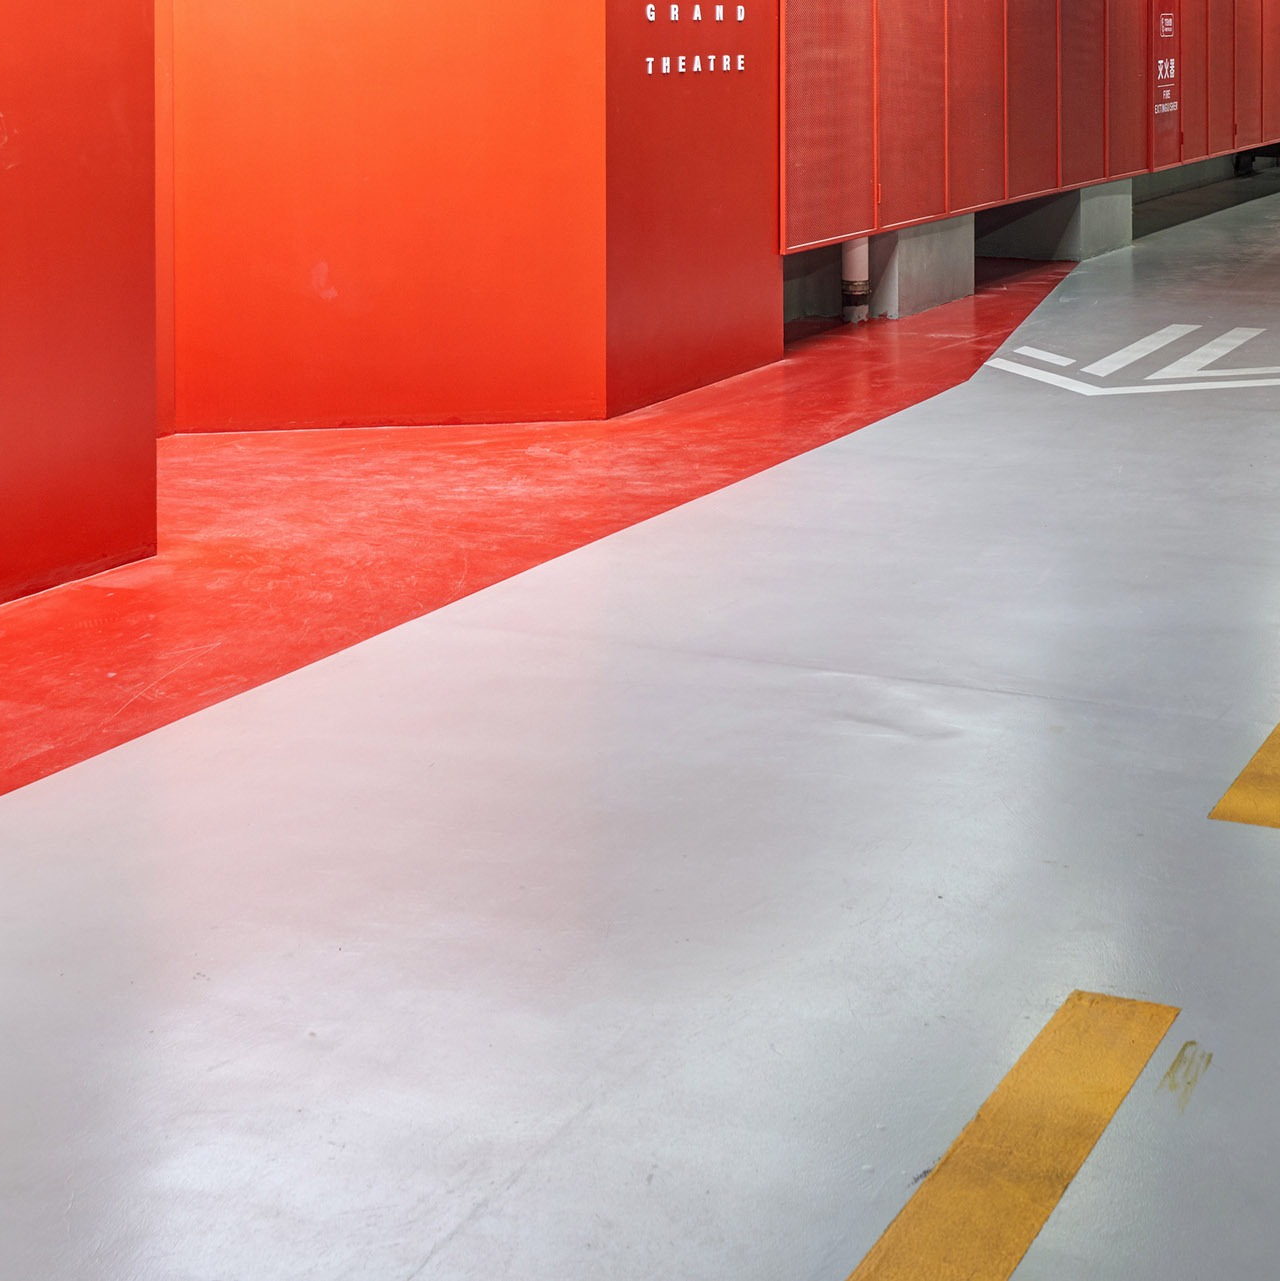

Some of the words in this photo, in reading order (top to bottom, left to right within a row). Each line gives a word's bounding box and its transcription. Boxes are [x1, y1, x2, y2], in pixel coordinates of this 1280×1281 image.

[646, 4, 746, 22] GRAND
[646, 54, 746, 74] THEATRE
[1158, 59, 1175, 80] 灭火器
